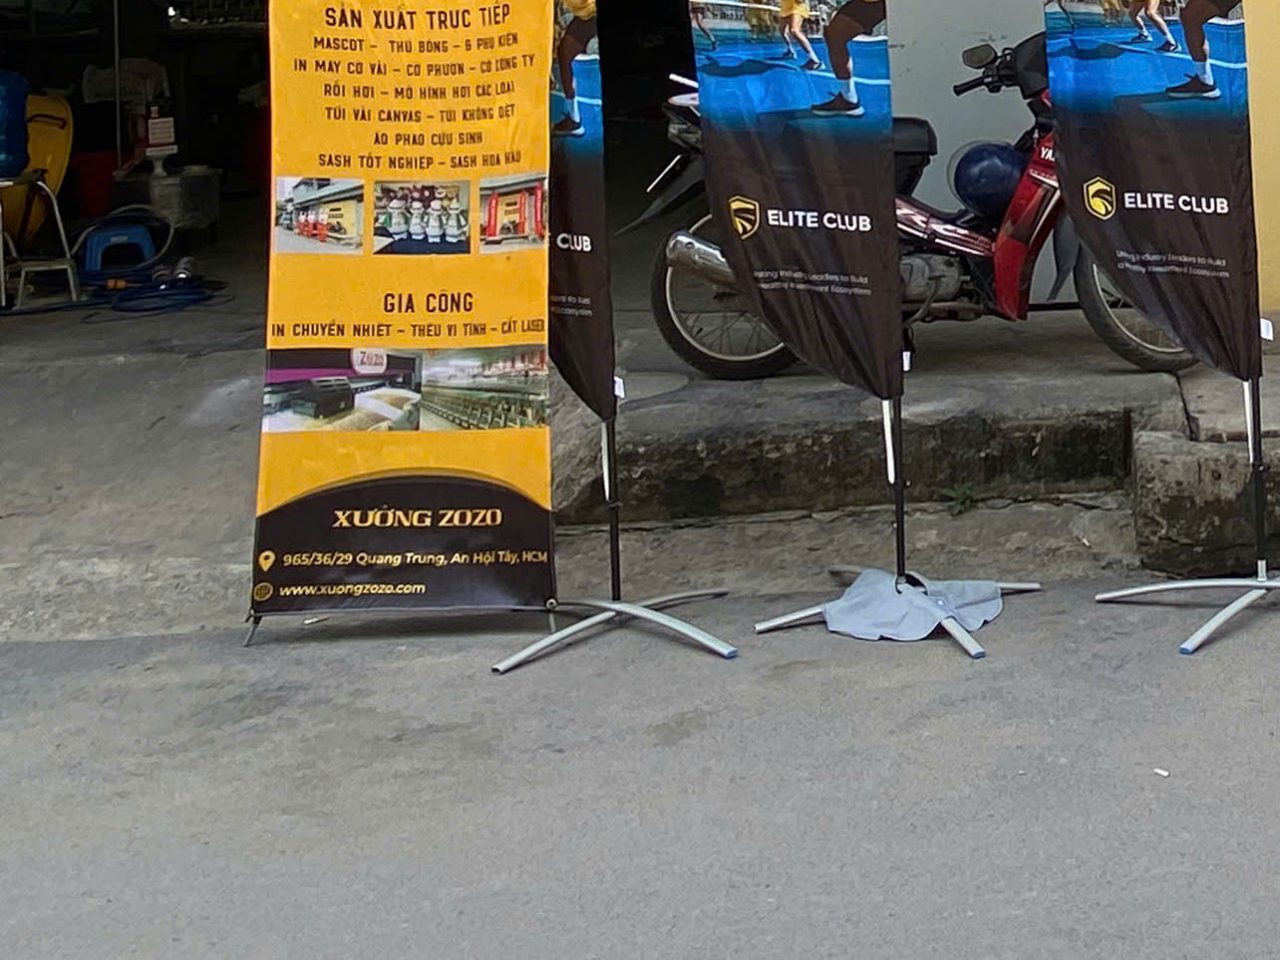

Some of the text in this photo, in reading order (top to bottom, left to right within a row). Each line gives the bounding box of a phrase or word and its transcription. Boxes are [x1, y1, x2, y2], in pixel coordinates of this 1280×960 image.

[313, 36, 364, 52] MASCOT
[294, 58, 307, 72] IN
[315, 60, 340, 74] MAY
[522, 54, 536, 67] TY
[378, 110, 421, 122] CANVAS
[395, 133, 424, 146] PHAO
[458, 132, 483, 145] SINH
[318, 154, 352, 168] SASH
[450, 155, 477, 168] SASH
[1124, 192, 1230, 214] ELITE CLUB
[767, 210, 872, 232] ELITE CLUB
[556, 233, 592, 252] CLUB
[383, 289, 474, 314] GIA CÔNG
[272, 323, 285, 336] IN
[438, 508, 502, 528] ZOZO
[283, 552, 353, 567] 965/36/29
[356, 552, 402, 567] Quang
[405, 552, 448, 567] Trung,
[450, 552, 470, 564] An
[473, 550, 496, 566] Hội
[522, 550, 548, 564] HCM
[279, 584, 426, 597] www.xuongzozo.com
